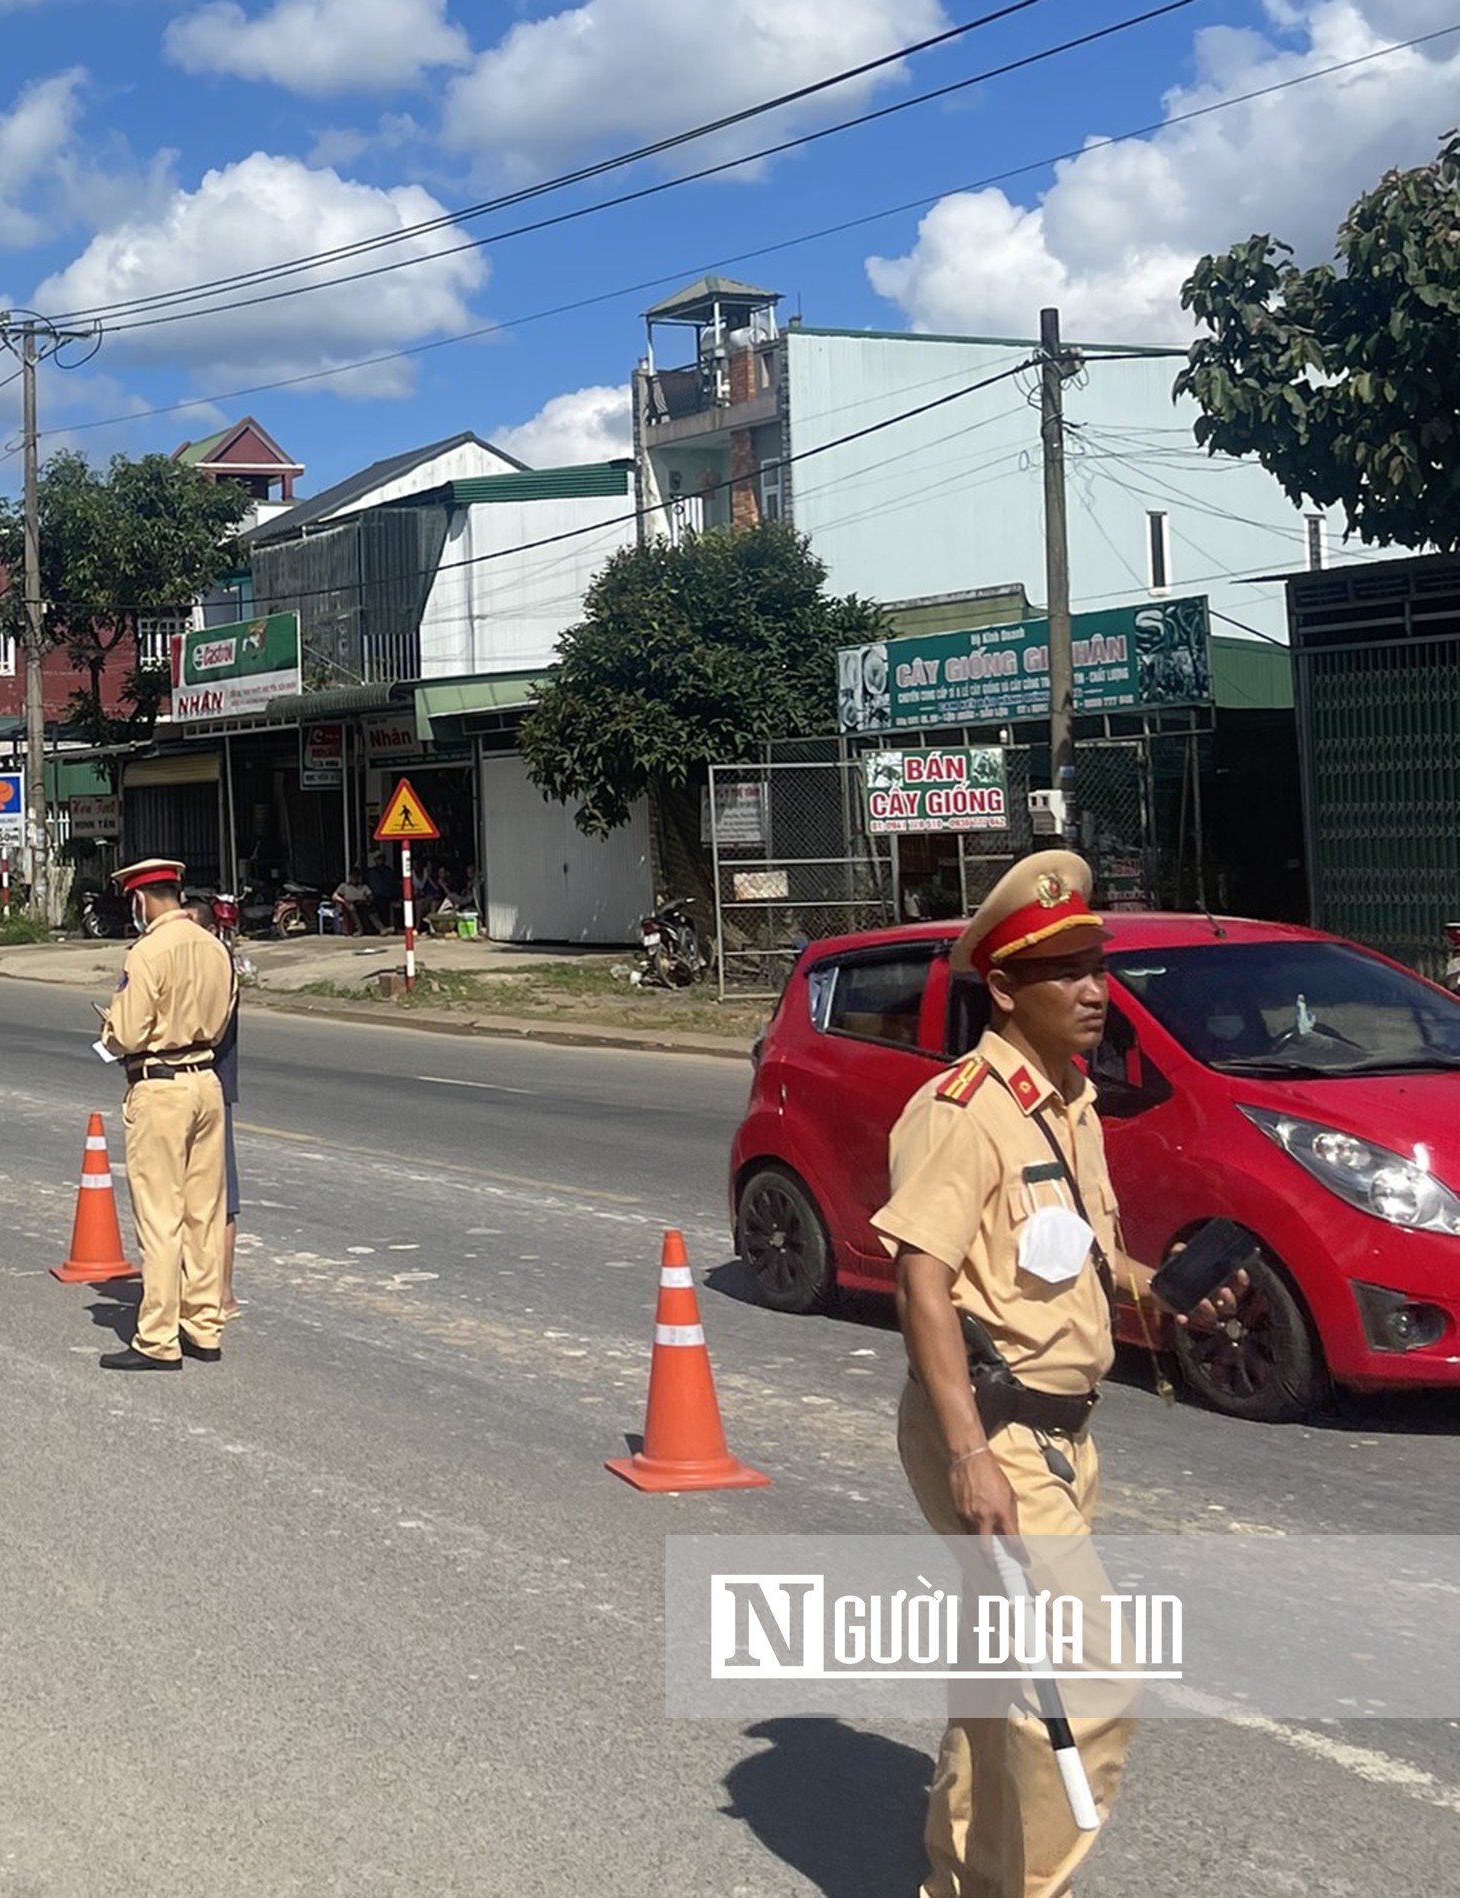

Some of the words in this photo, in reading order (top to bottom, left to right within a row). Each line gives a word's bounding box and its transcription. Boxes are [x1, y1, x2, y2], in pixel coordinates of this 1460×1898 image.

[896, 657, 940, 688] CÂY
[944, 647, 1018, 683] GIỐNG
[1023, 646, 1050, 672] GI
[179, 690, 223, 715] NHÂN
[370, 729, 412, 748] Nhân
[904, 751, 966, 783] BÁN
[870, 784, 921, 818] CÂY
[926, 781, 1005, 816] GIỐNG
